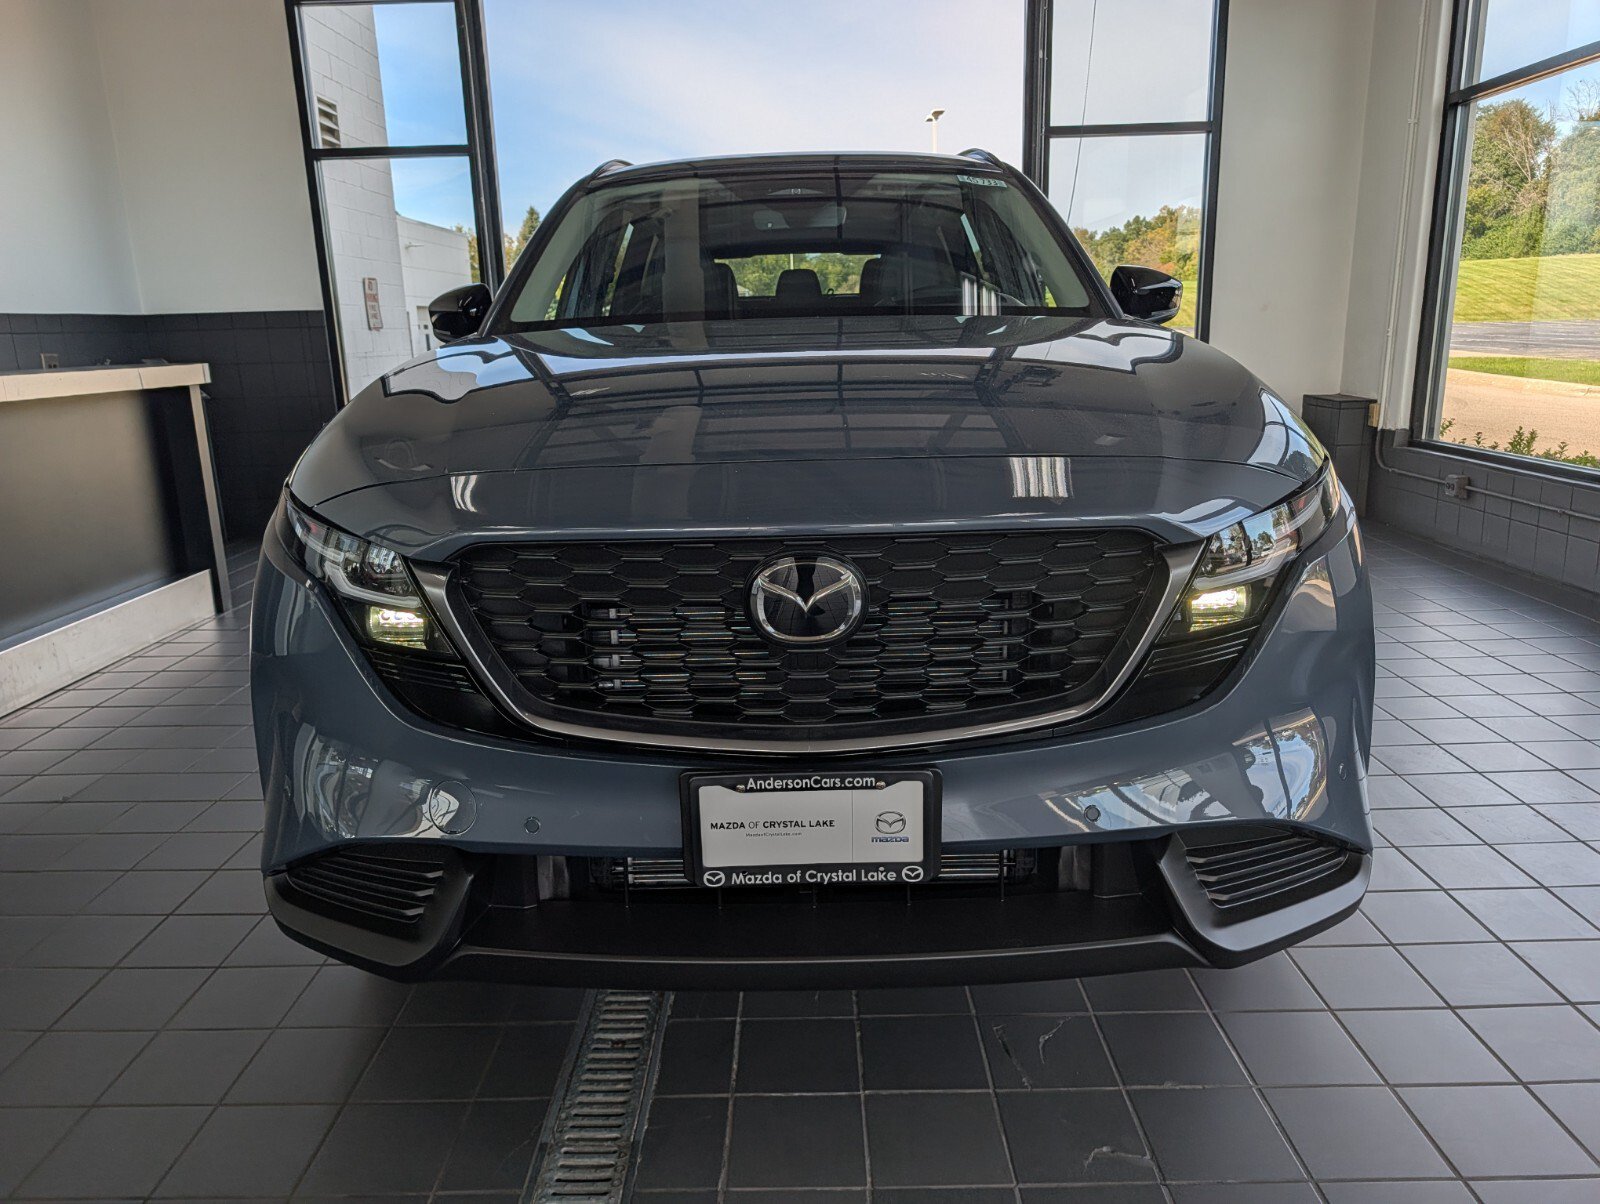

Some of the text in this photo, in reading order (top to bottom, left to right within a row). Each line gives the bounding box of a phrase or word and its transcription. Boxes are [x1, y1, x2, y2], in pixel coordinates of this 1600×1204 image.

[746, 776, 876, 790] AndersonCars.com
[710, 820, 836, 830] MAZDA OF CRYSTAL LAKE
[731, 868, 897, 885] Mazda of Crystal Lake
